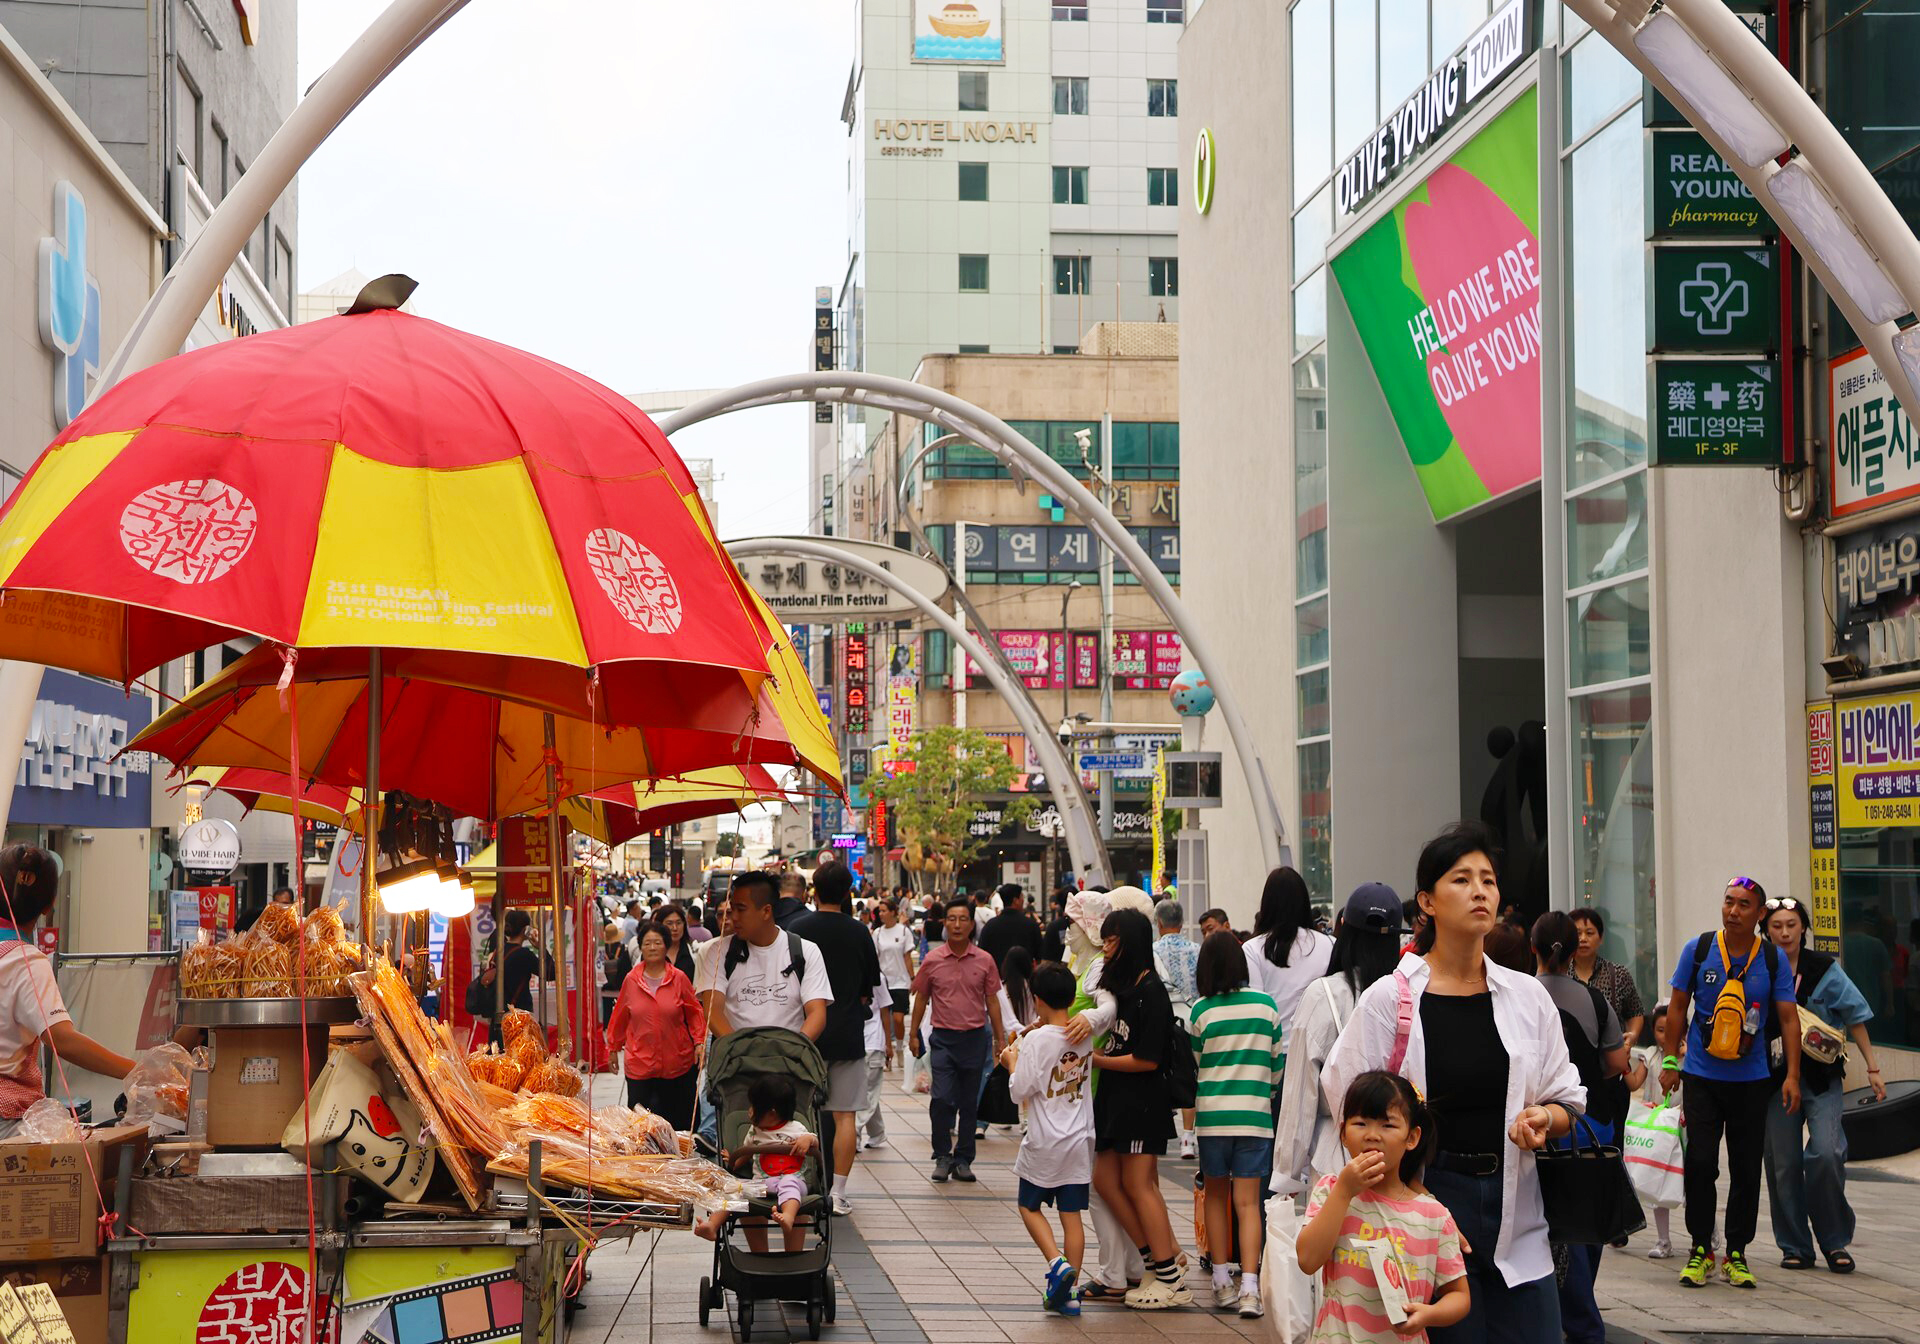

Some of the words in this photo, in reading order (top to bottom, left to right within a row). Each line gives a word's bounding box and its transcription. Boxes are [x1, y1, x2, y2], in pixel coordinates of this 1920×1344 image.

[1339, 125, 1388, 215] OLIVE
[1391, 56, 1459, 170] YOUNG
[1470, 6, 1518, 88] TOWN
[874, 118, 961, 141] HOTEL
[963, 121, 1038, 144] NOAH
[1668, 203, 1759, 227] pharmacy
[1755, 252, 1766, 261] 2F
[1407, 288, 1467, 360] HELLO
[1459, 264, 1501, 323] WE
[1497, 238, 1540, 305] ARE
[1431, 341, 1490, 407] OLIVE
[1758, 366, 1768, 375] 1F
[1667, 380, 1696, 412] 藥
[1736, 381, 1765, 412] 药
[1839, 374, 1867, 399] 임플란트
[1667, 416, 1766, 439] 레디영약국
[1694, 443, 1709, 455] 1F
[1722, 443, 1739, 456] 3F
[1837, 396, 1920, 497] 애플치
[760, 562, 808, 591] 국제
[1838, 536, 1920, 608] 레인보우
[326, 580, 347, 593] 25
[374, 584, 450, 601] BUSAN
[763, 594, 818, 607] ernational
[820, 593, 844, 607] Film
[846, 593, 888, 607] Festival
[326, 606, 366, 619] 3-12
[453, 615, 497, 627] 2020
[327, 592, 438, 612] International
[442, 602, 481, 616] Film
[485, 602, 554, 618] Festival
[848, 636, 865, 724] 노래연습장
[892, 692, 912, 744] 노래방
[1809, 710, 1832, 741] 임대
[852, 753, 866, 763] GS
[852, 763, 866, 772] 25
[1810, 744, 1833, 776] 문의
[973, 810, 1001, 822] 산여행
[1870, 804, 1912, 820] 051-248-5494
[213, 849, 236, 859] HAIR
[523, 821, 549, 895] 닭꼬치
[1705, 974, 1717, 983] 27
[1338, 1248, 1369, 1268] THE
